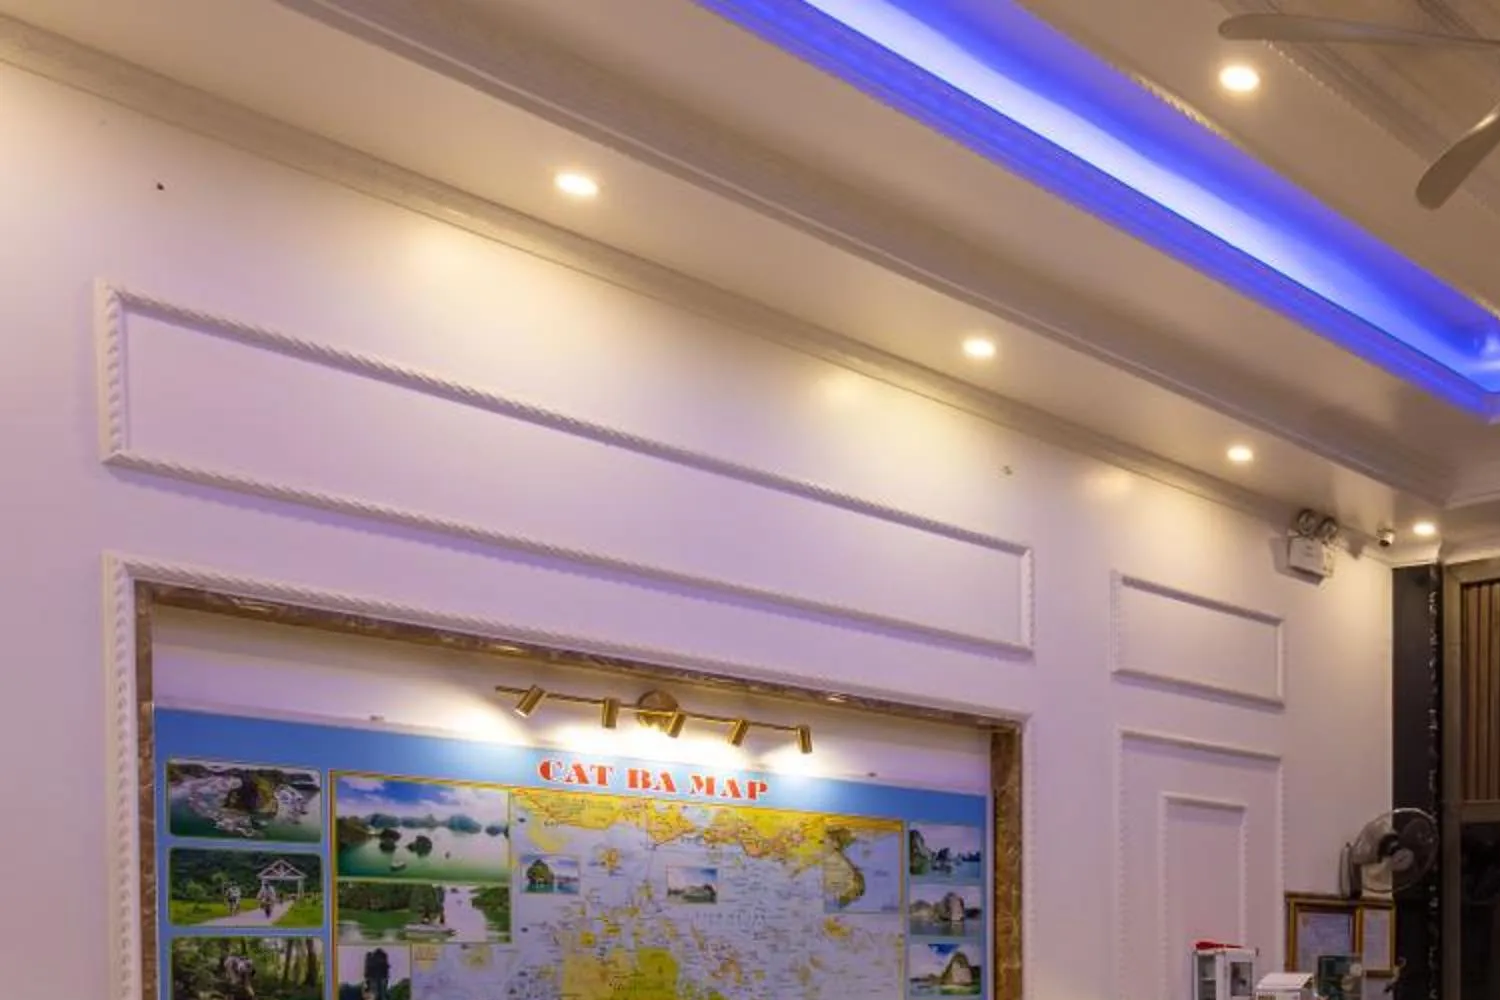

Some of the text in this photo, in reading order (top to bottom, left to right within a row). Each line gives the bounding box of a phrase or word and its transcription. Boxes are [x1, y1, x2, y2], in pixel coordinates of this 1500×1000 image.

[539, 759, 768, 800] CAT BA MAP
